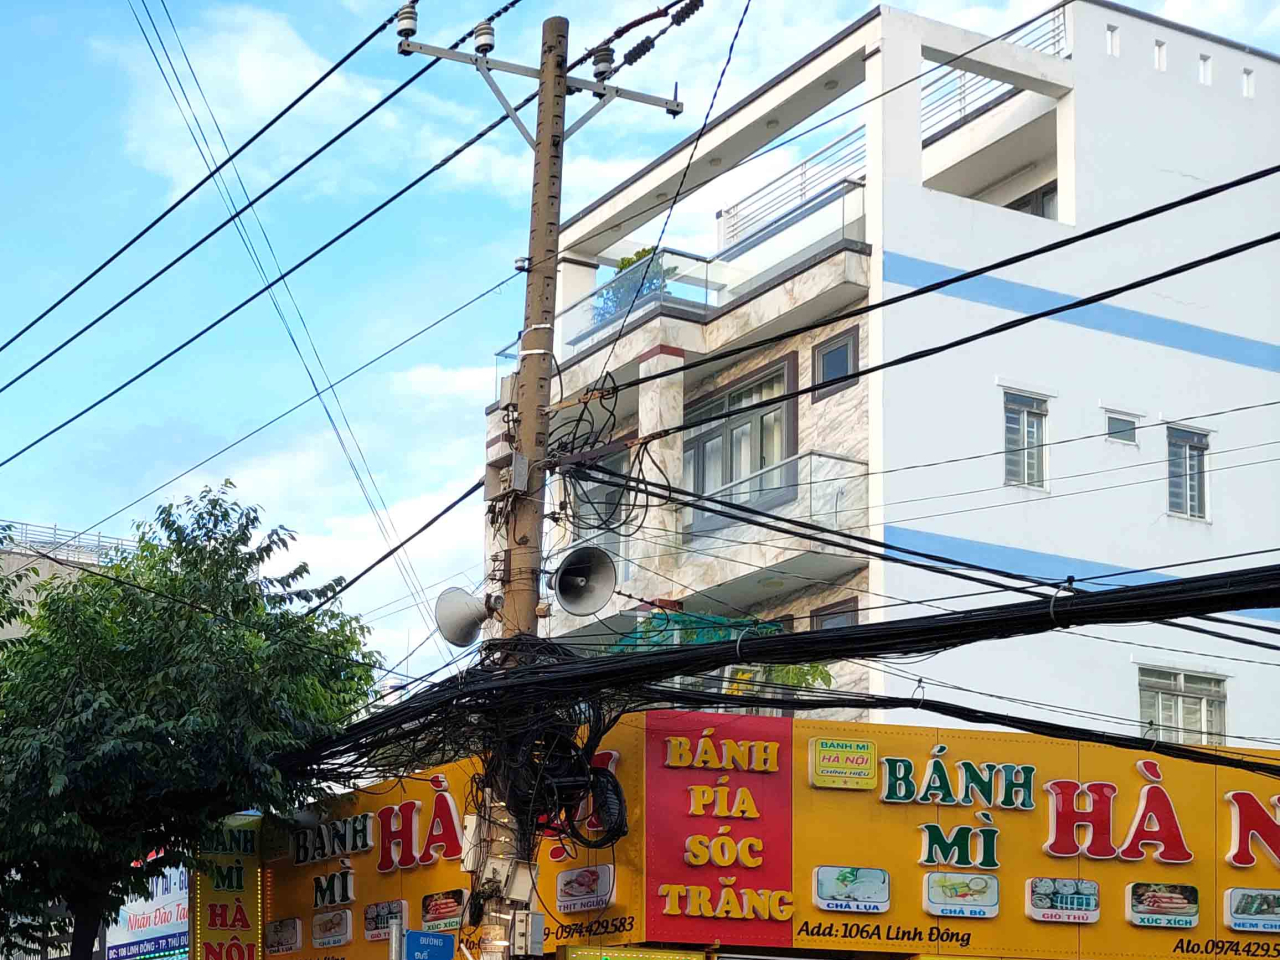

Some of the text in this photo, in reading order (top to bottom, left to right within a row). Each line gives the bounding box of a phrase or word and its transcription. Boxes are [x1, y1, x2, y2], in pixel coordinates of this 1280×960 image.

[664, 728, 780, 772] BÁNH
[821, 740, 869, 751] BÁNH MÌ
[822, 753, 869, 767] HÀ NỘI
[880, 744, 1036, 810] BÁNH
[687, 776, 760, 818] PÍA
[1042, 759, 1195, 864] HÀ
[377, 774, 464, 873] HÀ
[917, 811, 1001, 869] MÌ
[684, 826, 763, 867] SÓC
[213, 858, 245, 892] MÌ
[313, 858, 356, 909] MÌ
[207, 897, 252, 931] HÀ
[658, 876, 795, 921] TRĂNG
[826, 899, 880, 913] CHẢ LỤA
[941, 905, 986, 917] CHẢ BÒ
[1041, 910, 1089, 922] GIÒ THỦ
[1138, 914, 1193, 927] XÚC XÍCH
[1233, 921, 1259, 929] NEM
[126, 944, 139, 956] LINH
[140, 941, 155, 954] ĐÔNG
[420, 936, 443, 947] ĐƯỜNG
[886, 923, 923, 942] Linh
[927, 926, 971, 947] Đông
